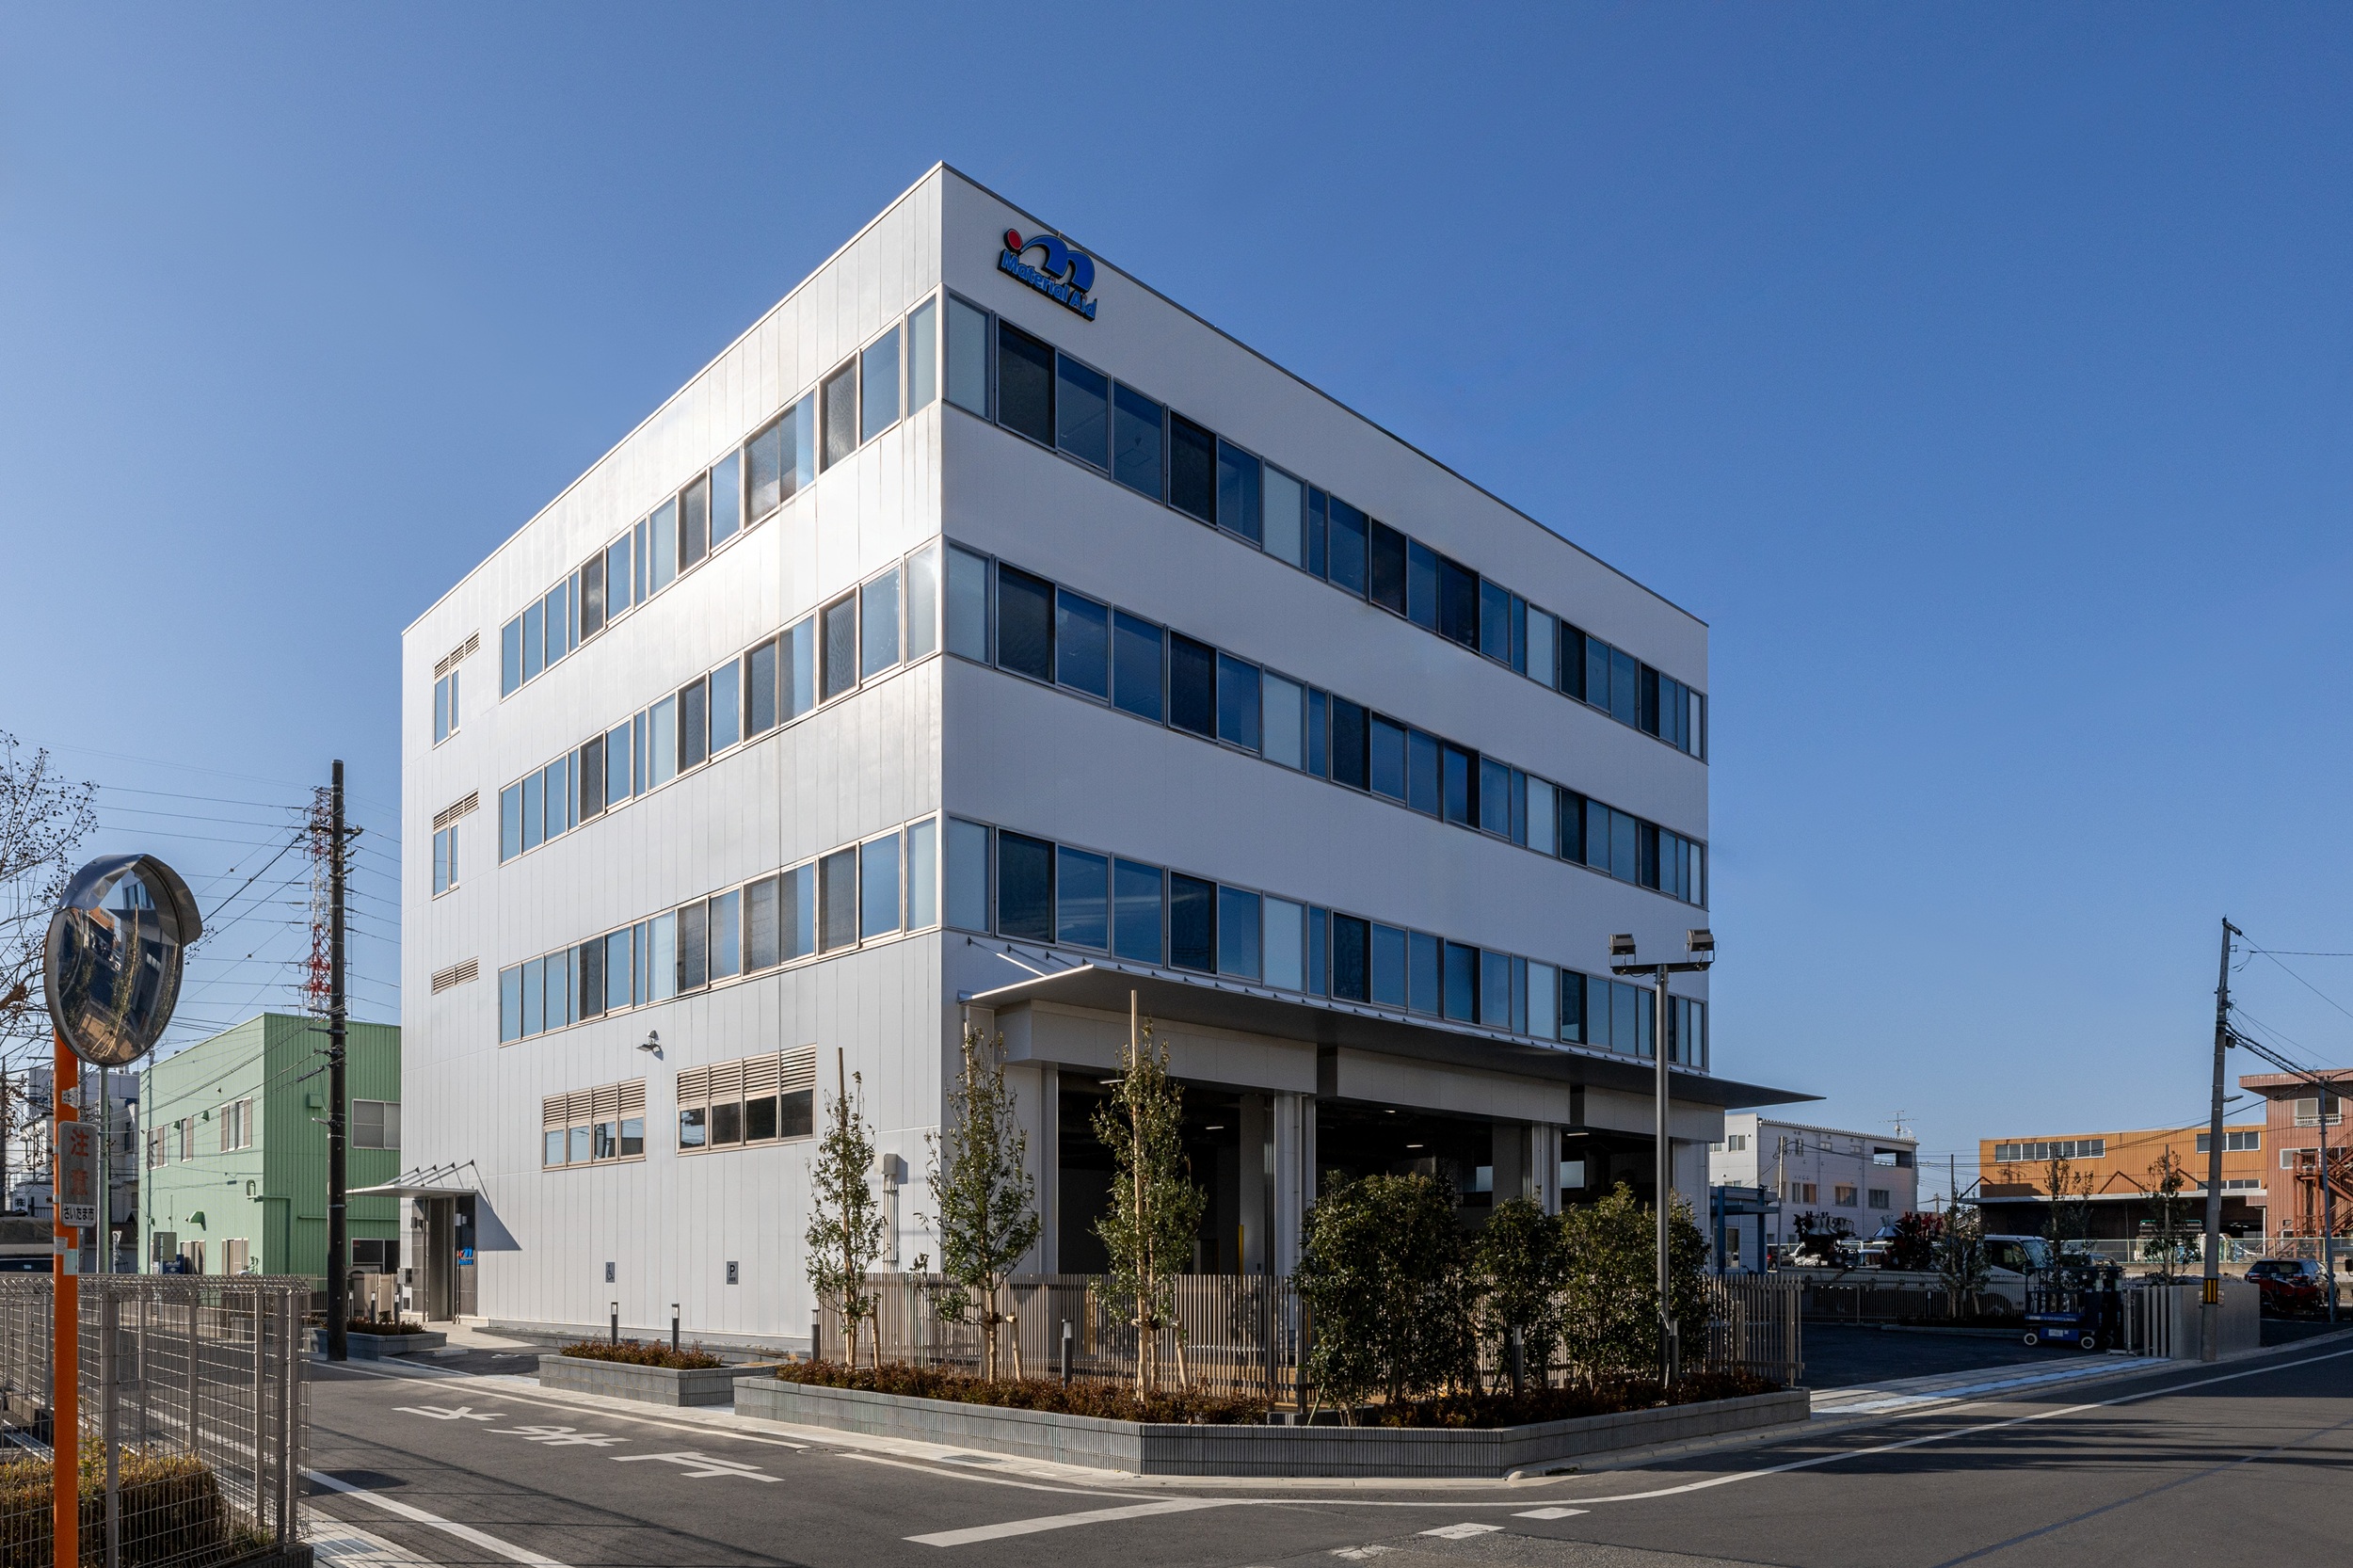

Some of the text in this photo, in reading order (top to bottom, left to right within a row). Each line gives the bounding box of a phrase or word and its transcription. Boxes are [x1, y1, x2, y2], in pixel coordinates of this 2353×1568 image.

[998, 248, 1097, 320] Material Aid
[70, 1128, 90, 1196] 注意
[63, 1206, 94, 1221] さいたま市
[729, 1264, 736, 1277] P
